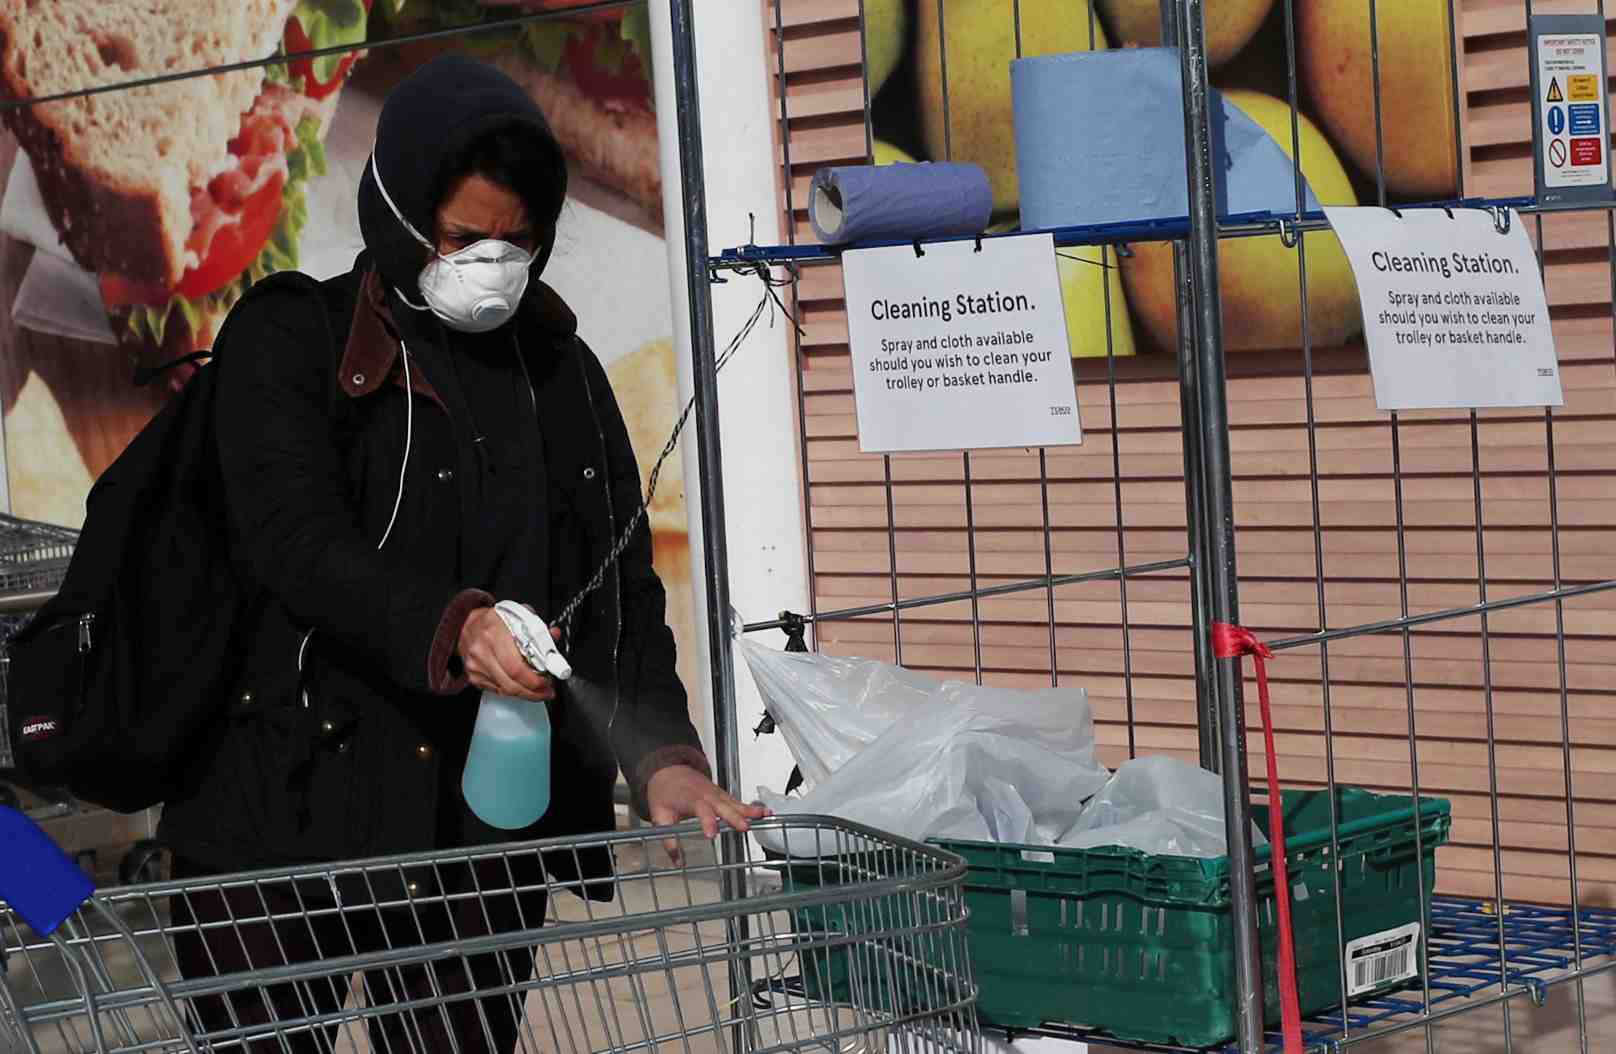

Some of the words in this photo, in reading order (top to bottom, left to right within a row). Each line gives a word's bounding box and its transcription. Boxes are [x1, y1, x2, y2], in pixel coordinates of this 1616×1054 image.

[1371, 251, 1451, 278] Cleaning
[1452, 252, 1519, 274] Station.
[871, 297, 951, 322] Cleaning
[956, 291, 1036, 316] Station.
[1388, 291, 1419, 307] Spray
[1422, 292, 1441, 305] and
[1444, 292, 1472, 305] cloth
[1474, 292, 1521, 305] available
[1379, 310, 1416, 324] should
[1419, 312, 1438, 326] you
[1440, 311, 1465, 324] wish
[1467, 313, 1479, 324] to
[1481, 312, 1510, 325] clean
[1512, 313, 1536, 327] your
[881, 338, 913, 354] Spray
[916, 337, 937, 350] and
[941, 335, 973, 349] cloth
[976, 330, 1034, 346] available
[1396, 330, 1432, 346] trolley
[1435, 333, 1446, 344] or
[1449, 331, 1484, 344] basket
[1486, 331, 1526, 344] handle.
[870, 357, 908, 372] should
[911, 357, 932, 373] you
[935, 355, 963, 368] wish
[966, 354, 980, 367] to
[984, 352, 1018, 366] clean
[1022, 350, 1052, 366] your
[886, 375, 923, 391] trolley
[927, 376, 940, 388] or
[943, 373, 985, 387] basket
[988, 369, 1038, 384] handle.
